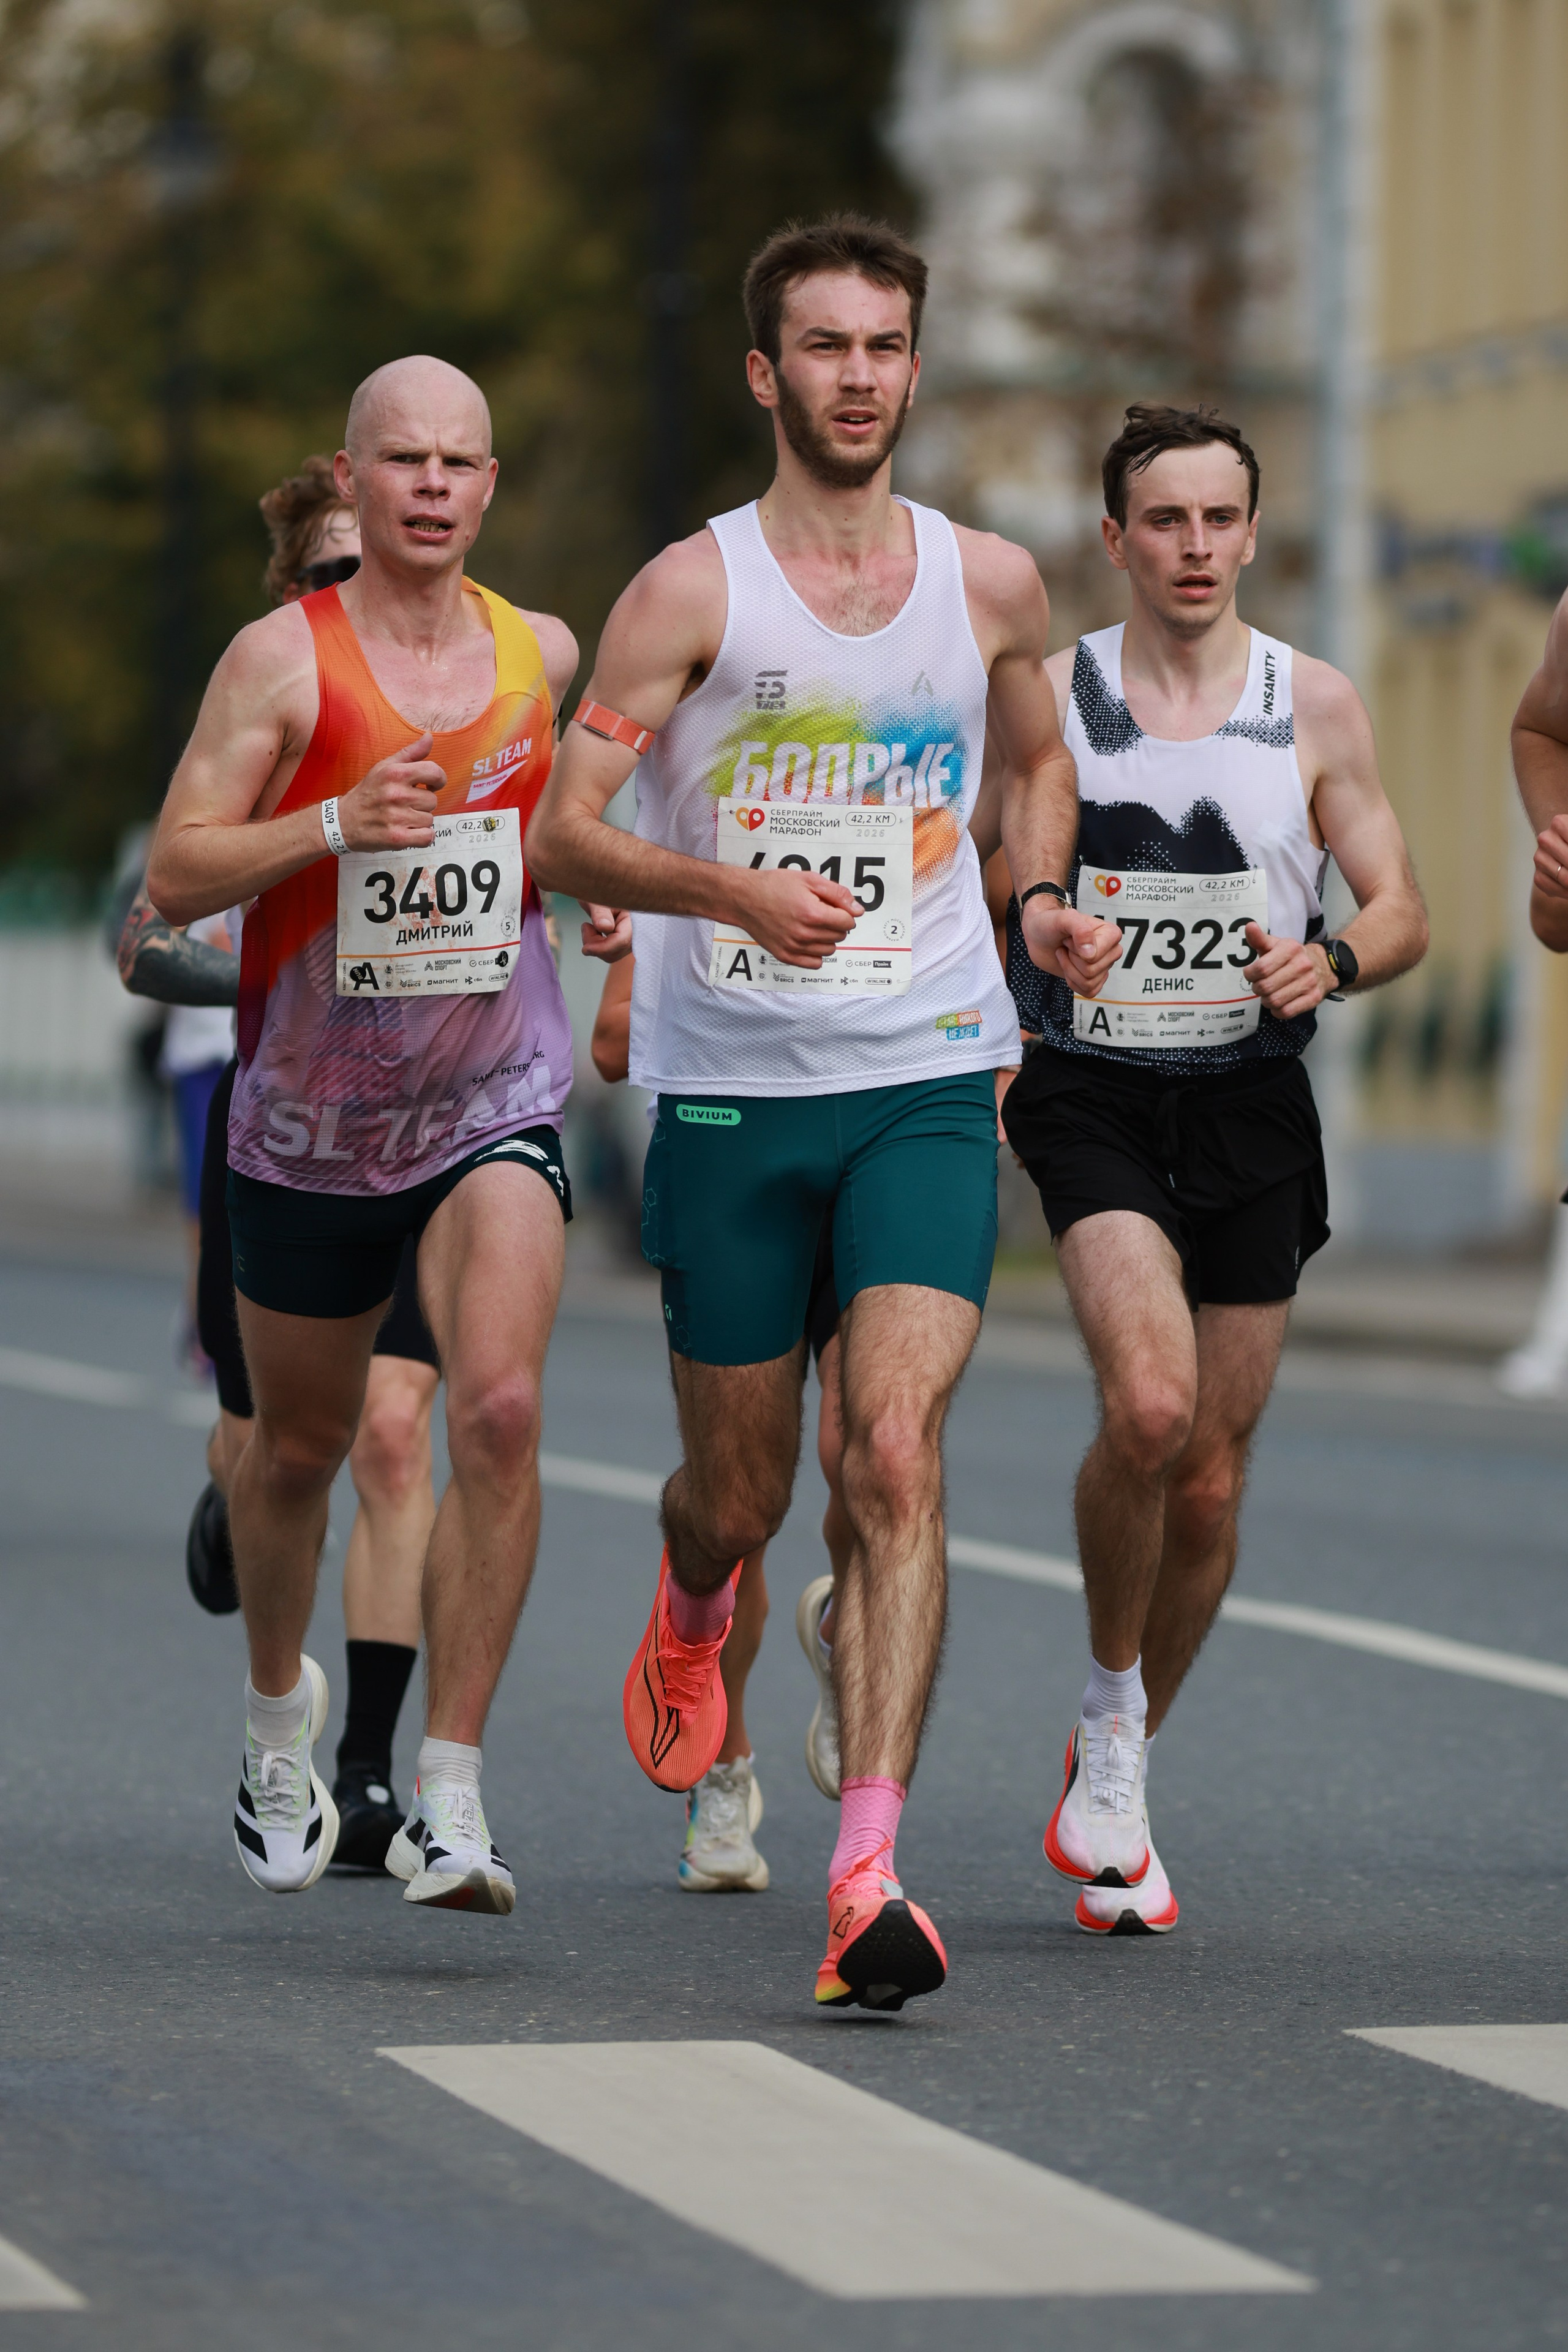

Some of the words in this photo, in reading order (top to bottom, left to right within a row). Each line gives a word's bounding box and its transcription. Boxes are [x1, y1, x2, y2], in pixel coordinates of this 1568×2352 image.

[1263, 650, 1275, 715] INSANITY
[472, 757, 492, 777] SL
[496, 737, 532, 769] TEAM
[325, 801, 334, 823] 3409
[771, 809, 823, 818] СБЕРПРАЙМ
[770, 817, 840, 828] МОСКОВСКИЙ
[851, 815, 872, 825] 42,2
[769, 826, 821, 836] МАРАФОН
[856, 829, 885, 838] 2026
[332, 831, 344, 849] 42,2
[469, 834, 496, 843] 2026
[1127, 876, 1176, 885] СБЕРПРАЙМ
[1205, 881, 1227, 890] 42,2
[363, 859, 500, 923] 3409
[1126, 884, 1194, 894] МОСКОВСКИЙ
[1126, 893, 1175, 902] МАРАФОН
[1210, 893, 1240, 902] 2026
[505, 921, 510, 930] 5
[891, 925, 897, 934] 2
[396, 921, 473, 945] ДМИТРИЙ
[353, 968, 364, 980] RUN
[1142, 978, 1194, 994] ДЕНИС
[682, 1109, 732, 1121] BIVIUM
[264, 1101, 355, 1161] SL
